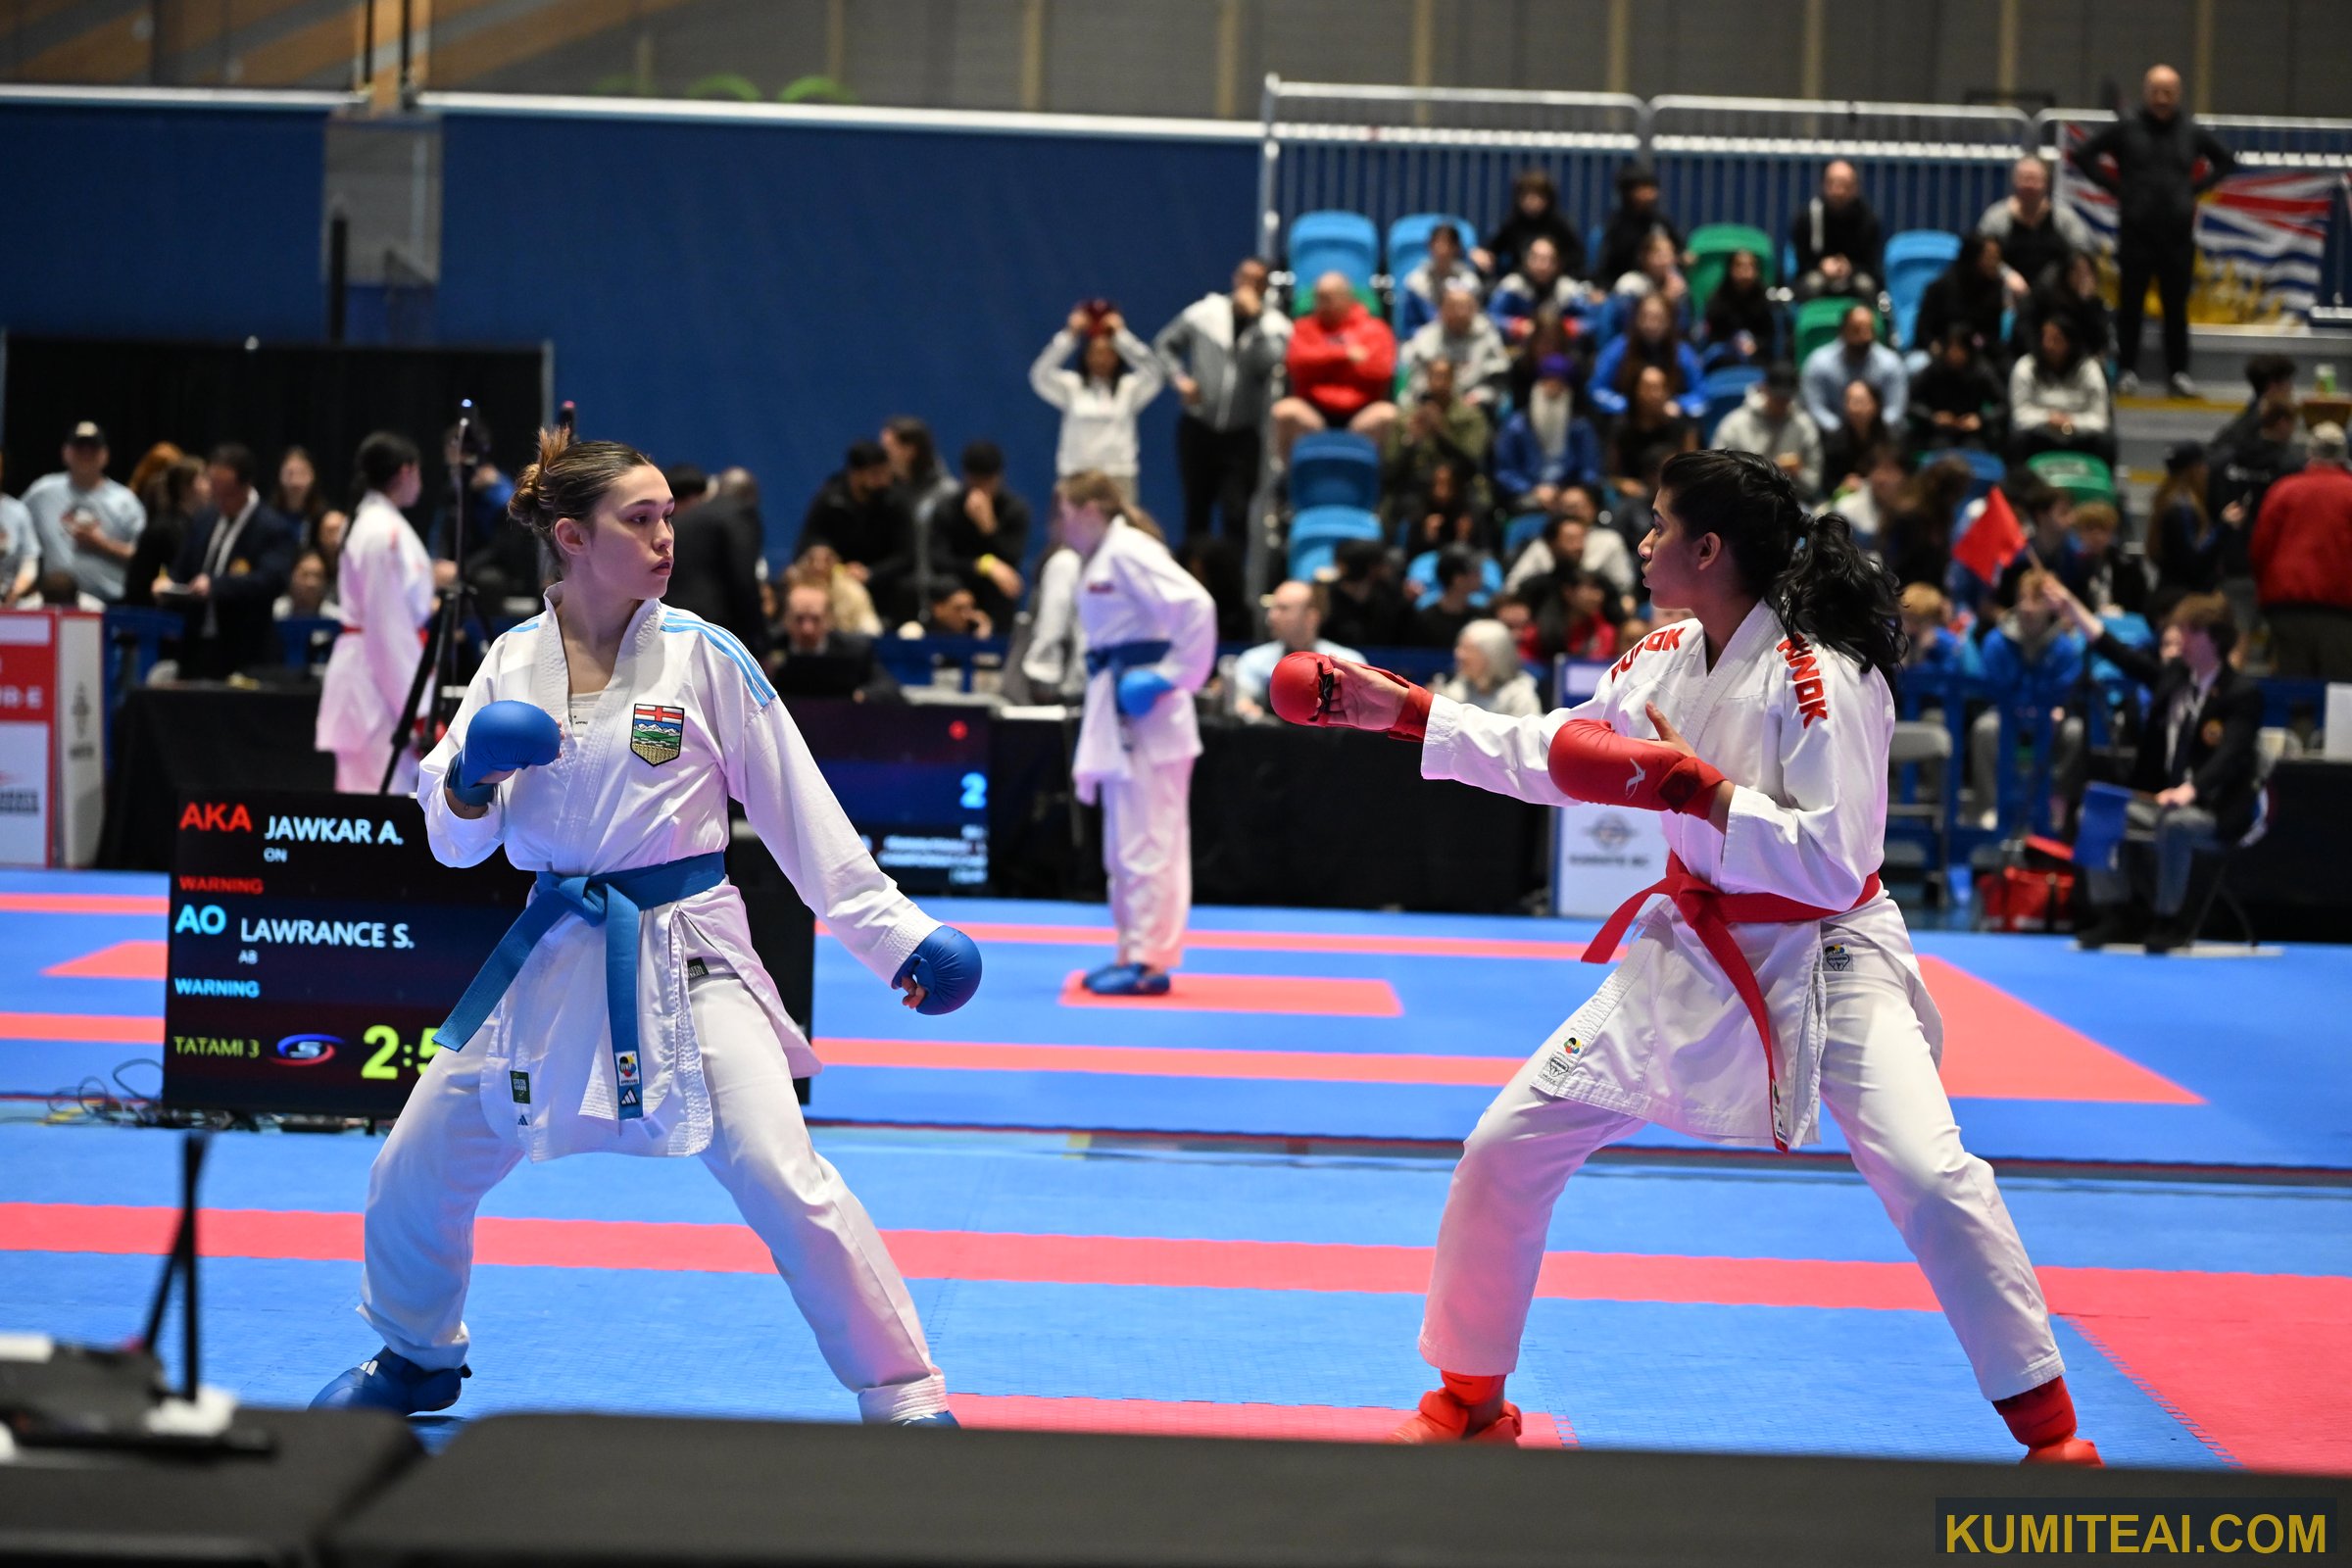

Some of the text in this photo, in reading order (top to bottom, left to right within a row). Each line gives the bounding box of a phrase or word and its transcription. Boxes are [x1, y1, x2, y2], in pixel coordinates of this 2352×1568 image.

[960, 772, 987, 809] 2
[179, 802, 252, 832] AKA
[264, 815, 404, 845] JAWKAR A.
[263, 847, 288, 862] ON
[178, 875, 264, 894] WARNING
[174, 904, 226, 935] AO
[240, 917, 415, 949] LAWRANCE S.
[238, 949, 259, 964] AB
[173, 977, 261, 999] WARNING
[172, 1035, 261, 1058] TATAMI 3
